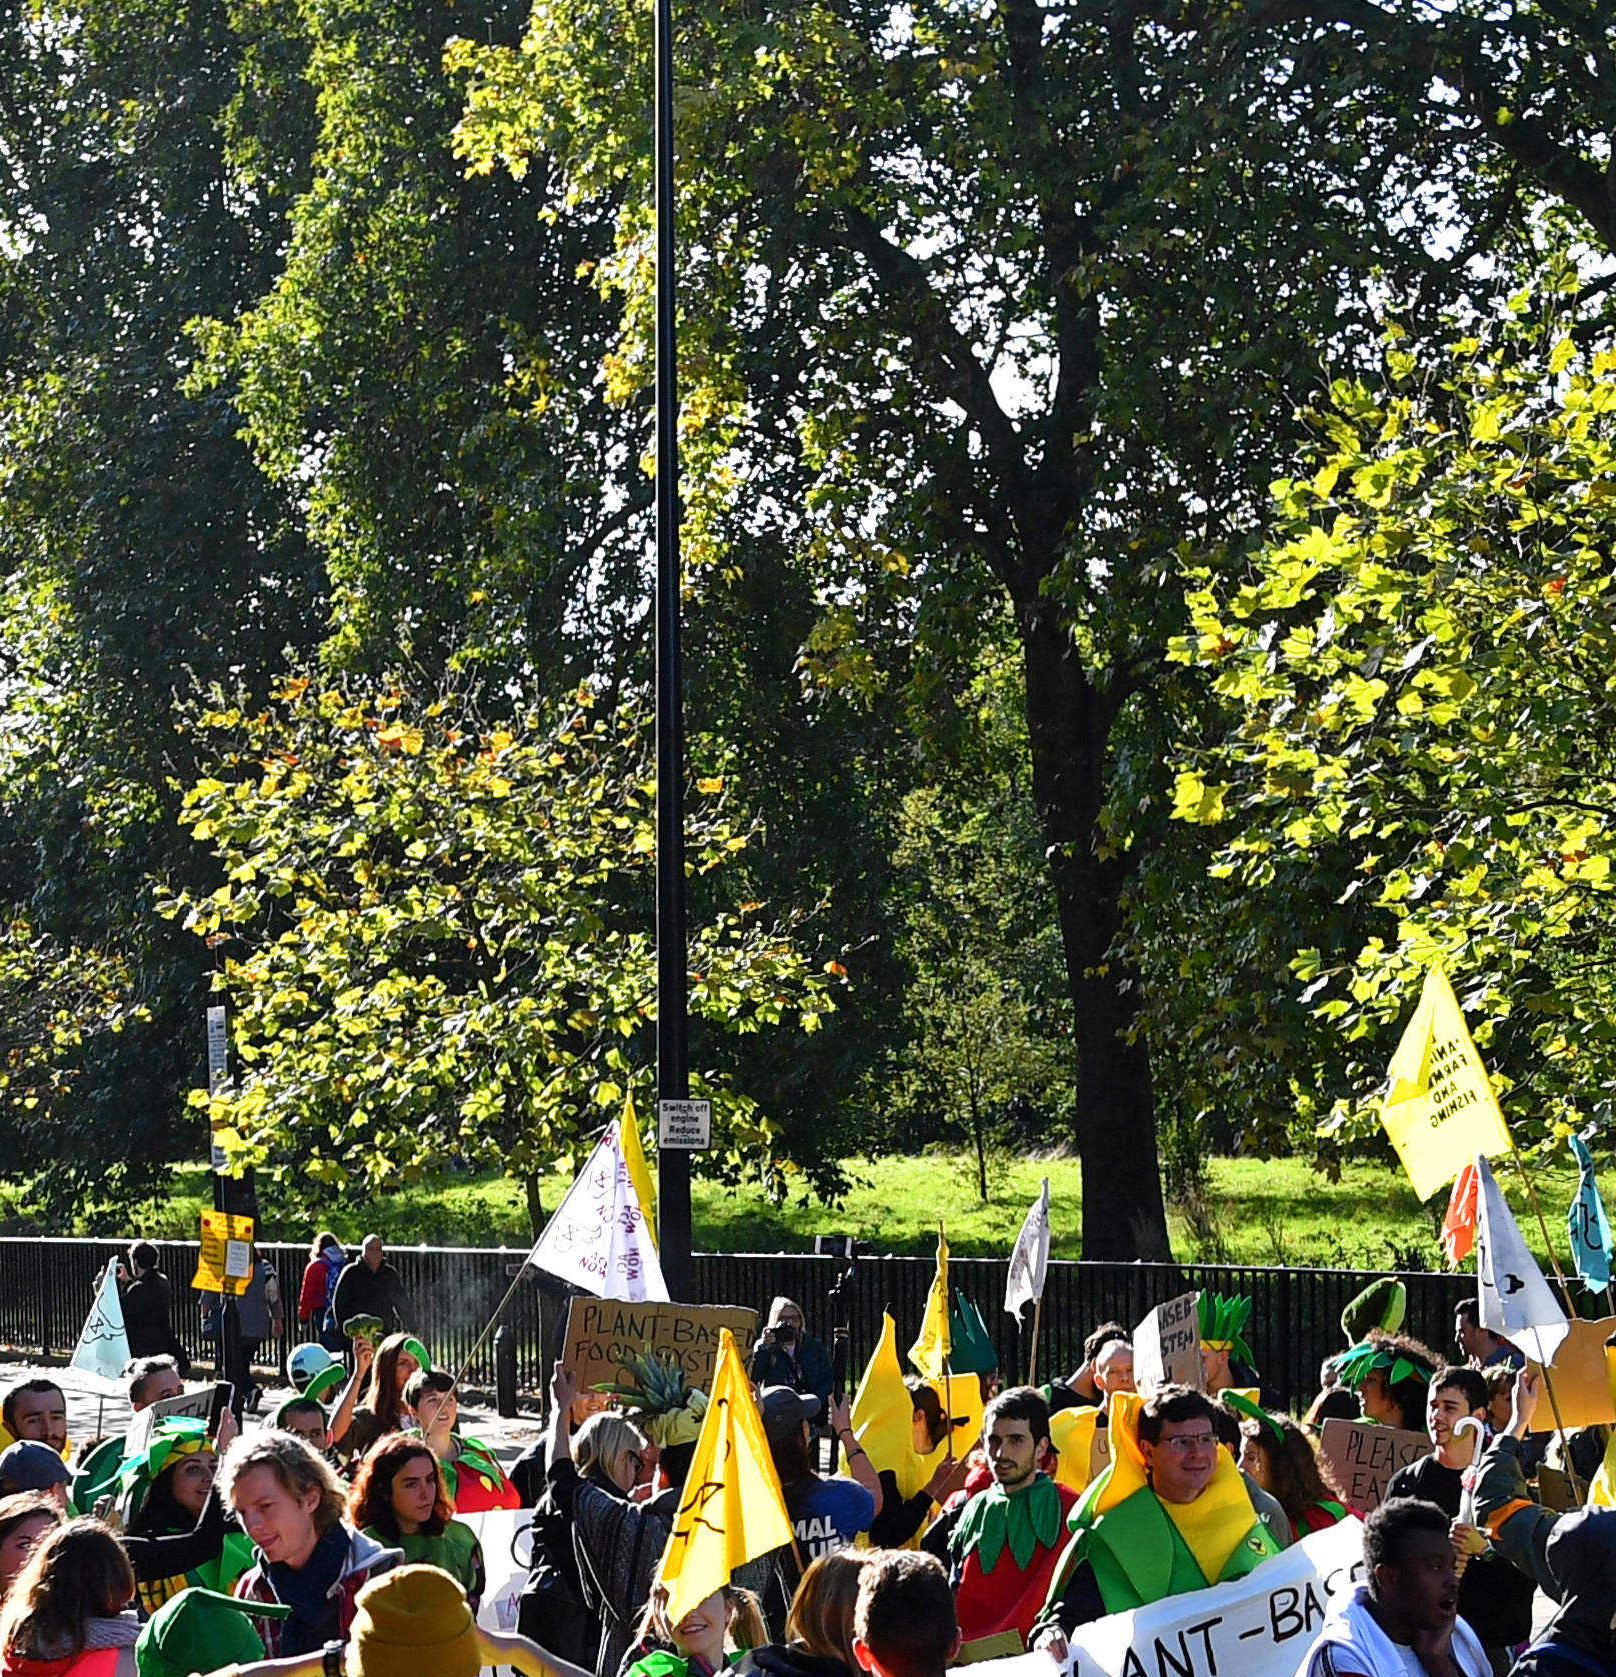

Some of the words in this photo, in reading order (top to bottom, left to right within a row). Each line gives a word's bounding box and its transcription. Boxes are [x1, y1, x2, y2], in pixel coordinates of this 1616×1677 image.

[662, 1103, 693, 1112] Switch
[695, 1104, 708, 1112] off
[671, 1116, 699, 1124] engine
[669, 1125, 701, 1134] Reduce
[663, 1136, 705, 1145] emissions
[656, 1346, 754, 1373] SYSTM
